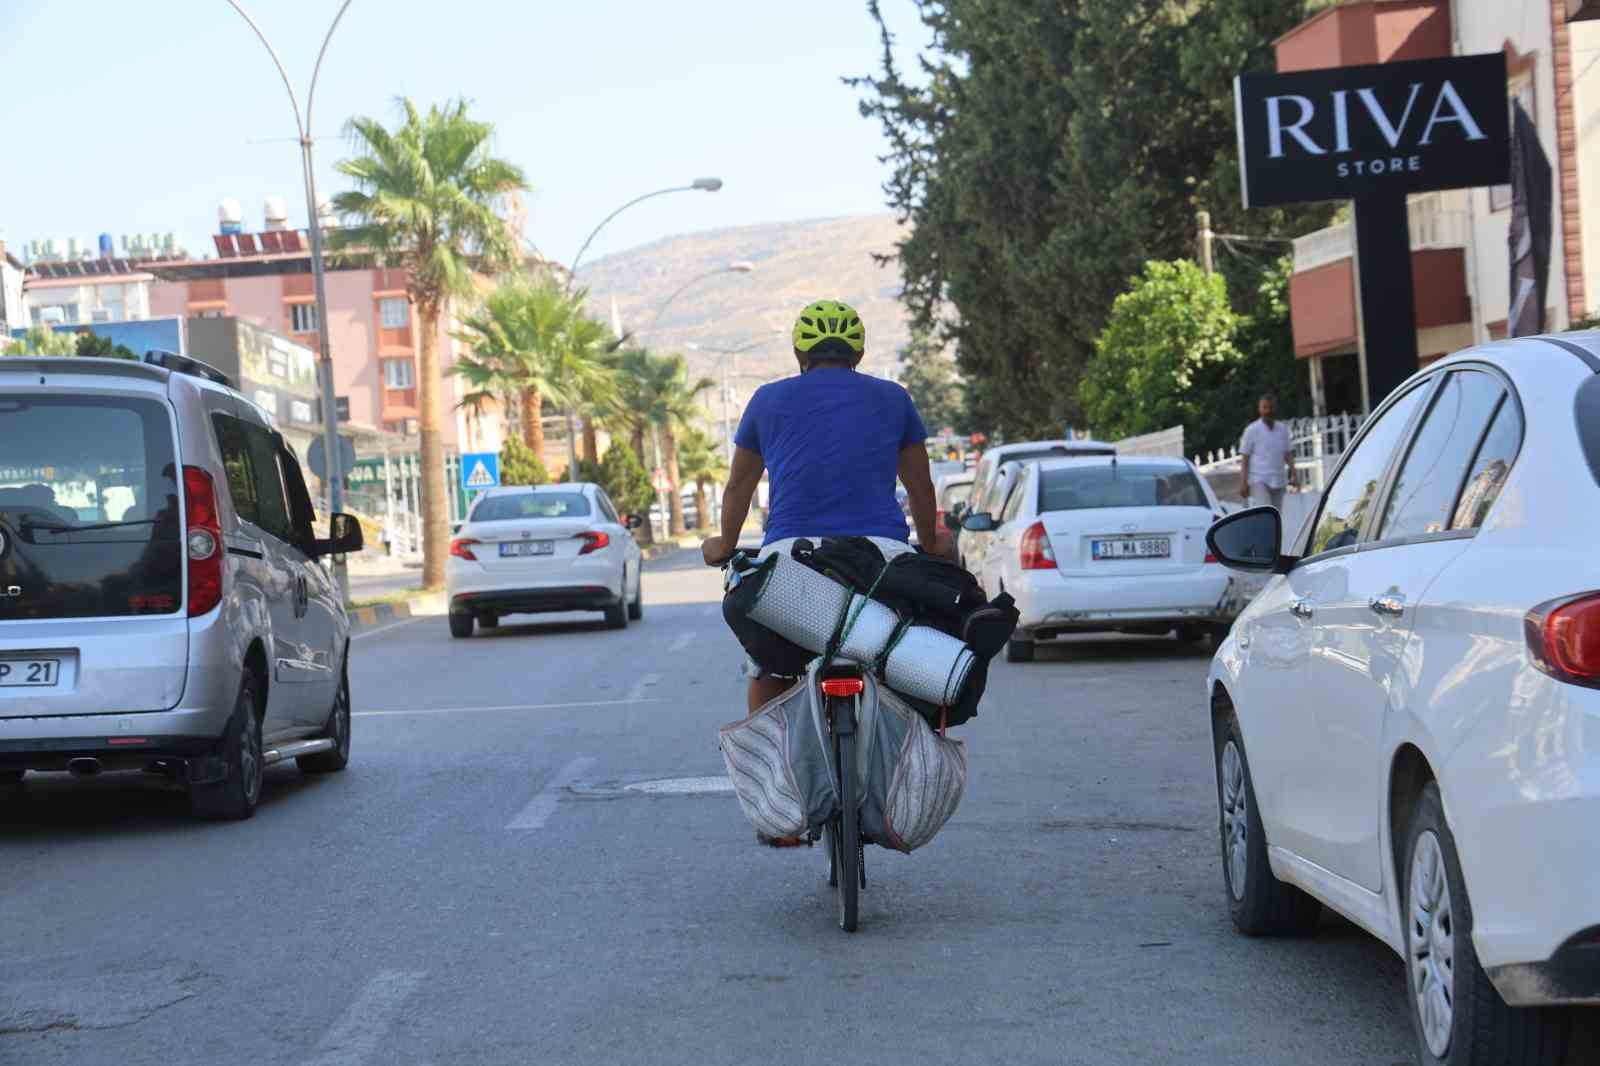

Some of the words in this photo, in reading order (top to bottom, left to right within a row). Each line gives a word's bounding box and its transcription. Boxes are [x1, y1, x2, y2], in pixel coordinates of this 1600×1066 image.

[1264, 79, 1489, 159] RIVA
[1336, 155, 1422, 177] STORE
[26, 662, 51, 683] 21
